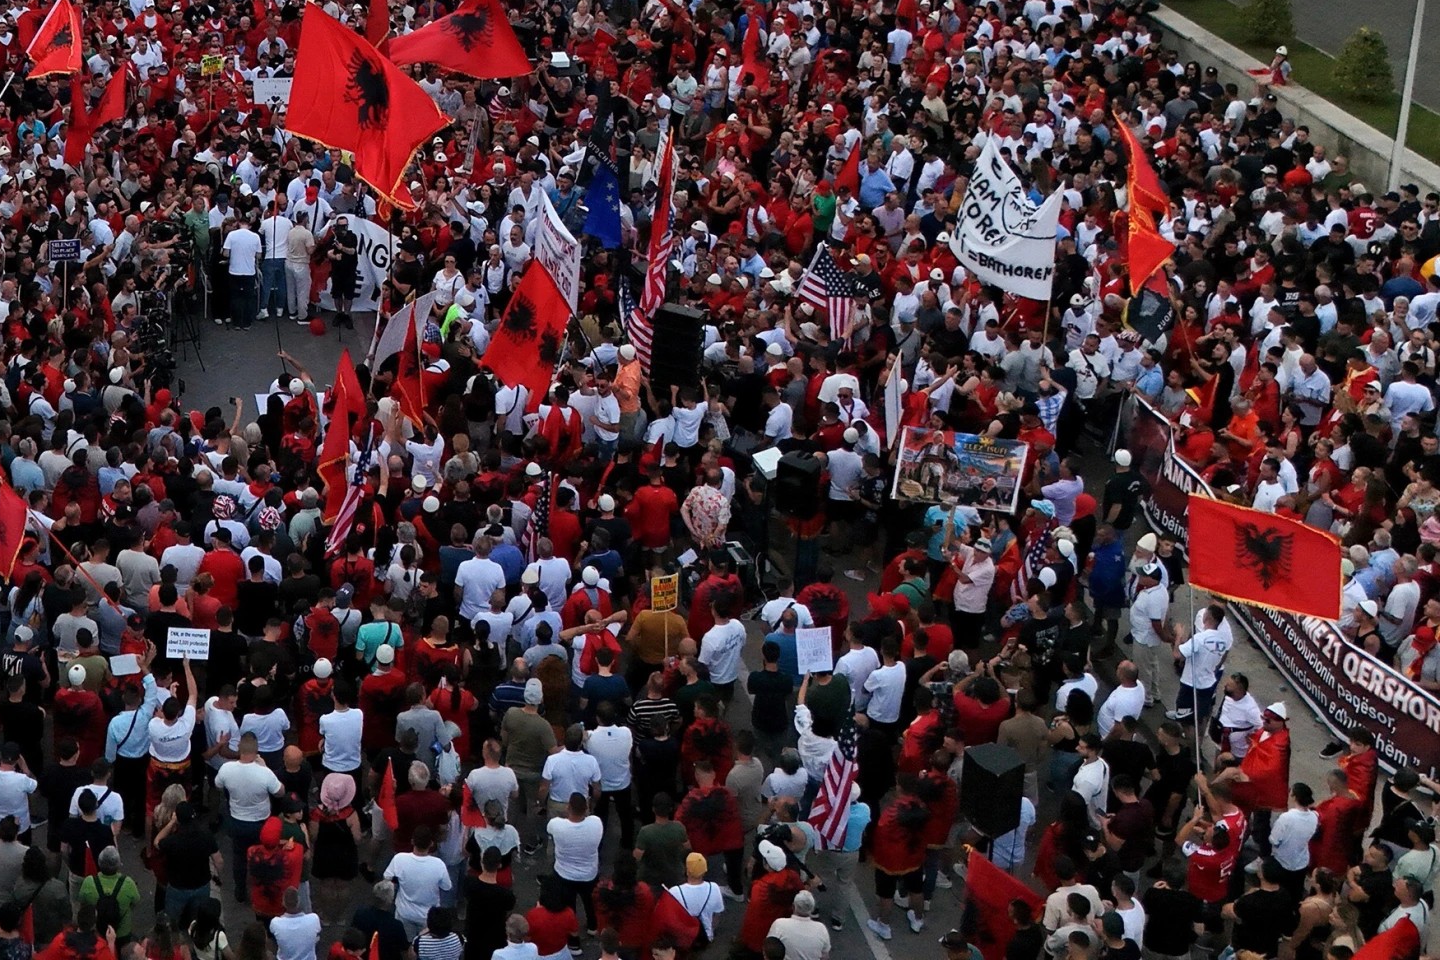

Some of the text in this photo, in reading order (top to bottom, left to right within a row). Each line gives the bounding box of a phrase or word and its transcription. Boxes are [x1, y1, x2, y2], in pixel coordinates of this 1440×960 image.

[1271, 640, 1328, 707] revolucionin
[1283, 624, 1336, 690] revolucionin
[1337, 682, 1397, 734] paqësor,
[1322, 633, 1343, 667] 21
